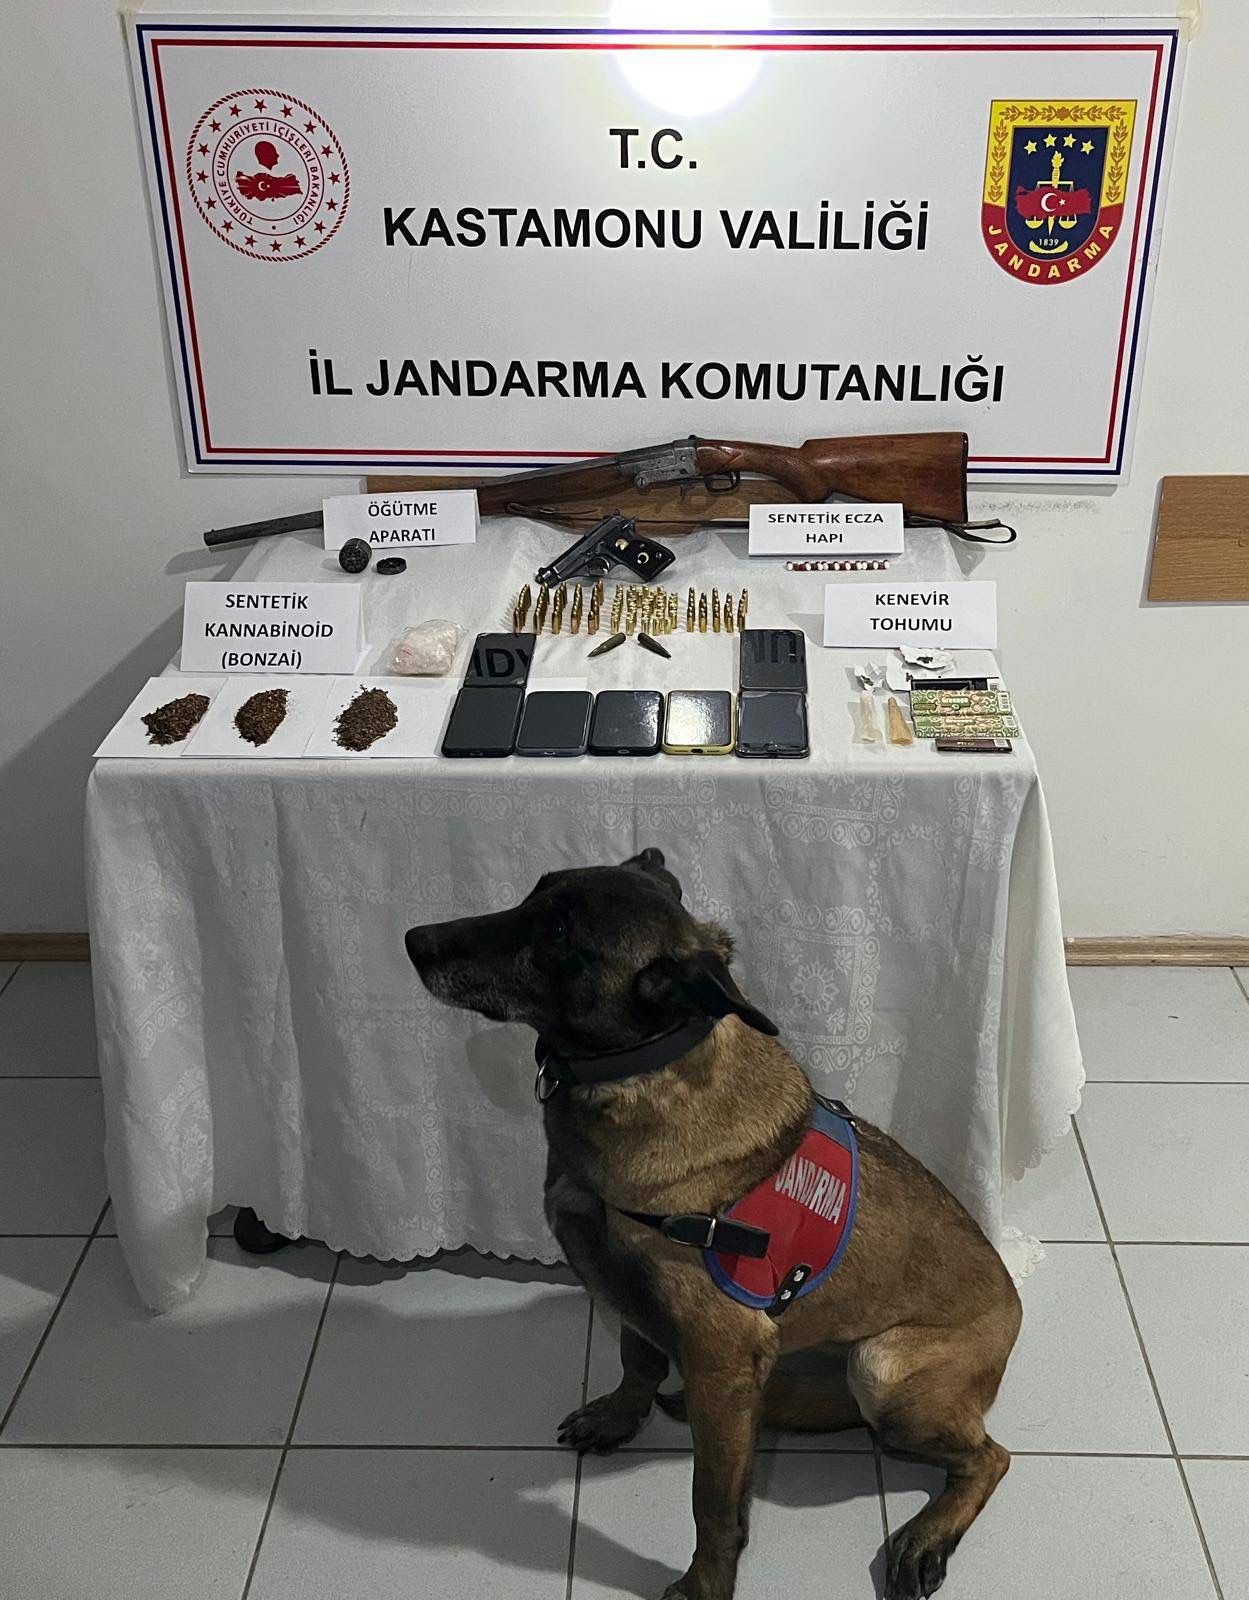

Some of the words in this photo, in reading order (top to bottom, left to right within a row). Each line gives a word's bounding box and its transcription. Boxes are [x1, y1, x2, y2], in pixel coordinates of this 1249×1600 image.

[217, 121, 269, 177] CUMHURİYETİ
[273, 122, 316, 162] İÇİŞLERİ
[610, 128, 698, 169] T.C.
[293, 166, 320, 225] BAKANLIĞI
[384, 207, 702, 249] KASTAMONU
[720, 199, 929, 251] VALİLİĞİ
[1039, 238, 1059, 246] 1839
[988, 224, 1114, 279] JANDARMA
[308, 348, 353, 396] İL
[366, 359, 647, 399] JANDARMA
[661, 354, 1004, 403] KOMUTANLIĞI
[368, 500, 438, 517] ÖĞÜTME
[768, 512, 841, 525] SENTETİK
[845, 513, 884, 524] ECZA
[369, 528, 436, 543] APARATI
[806, 533, 843, 544] HAPI
[225, 592, 309, 610] SENTETİK
[875, 590, 950, 606] KENEVİR
[205, 621, 334, 638] KANNABİNOİD
[870, 617, 953, 632] TOHUMU
[221, 650, 302, 670] (BONZAİ)
